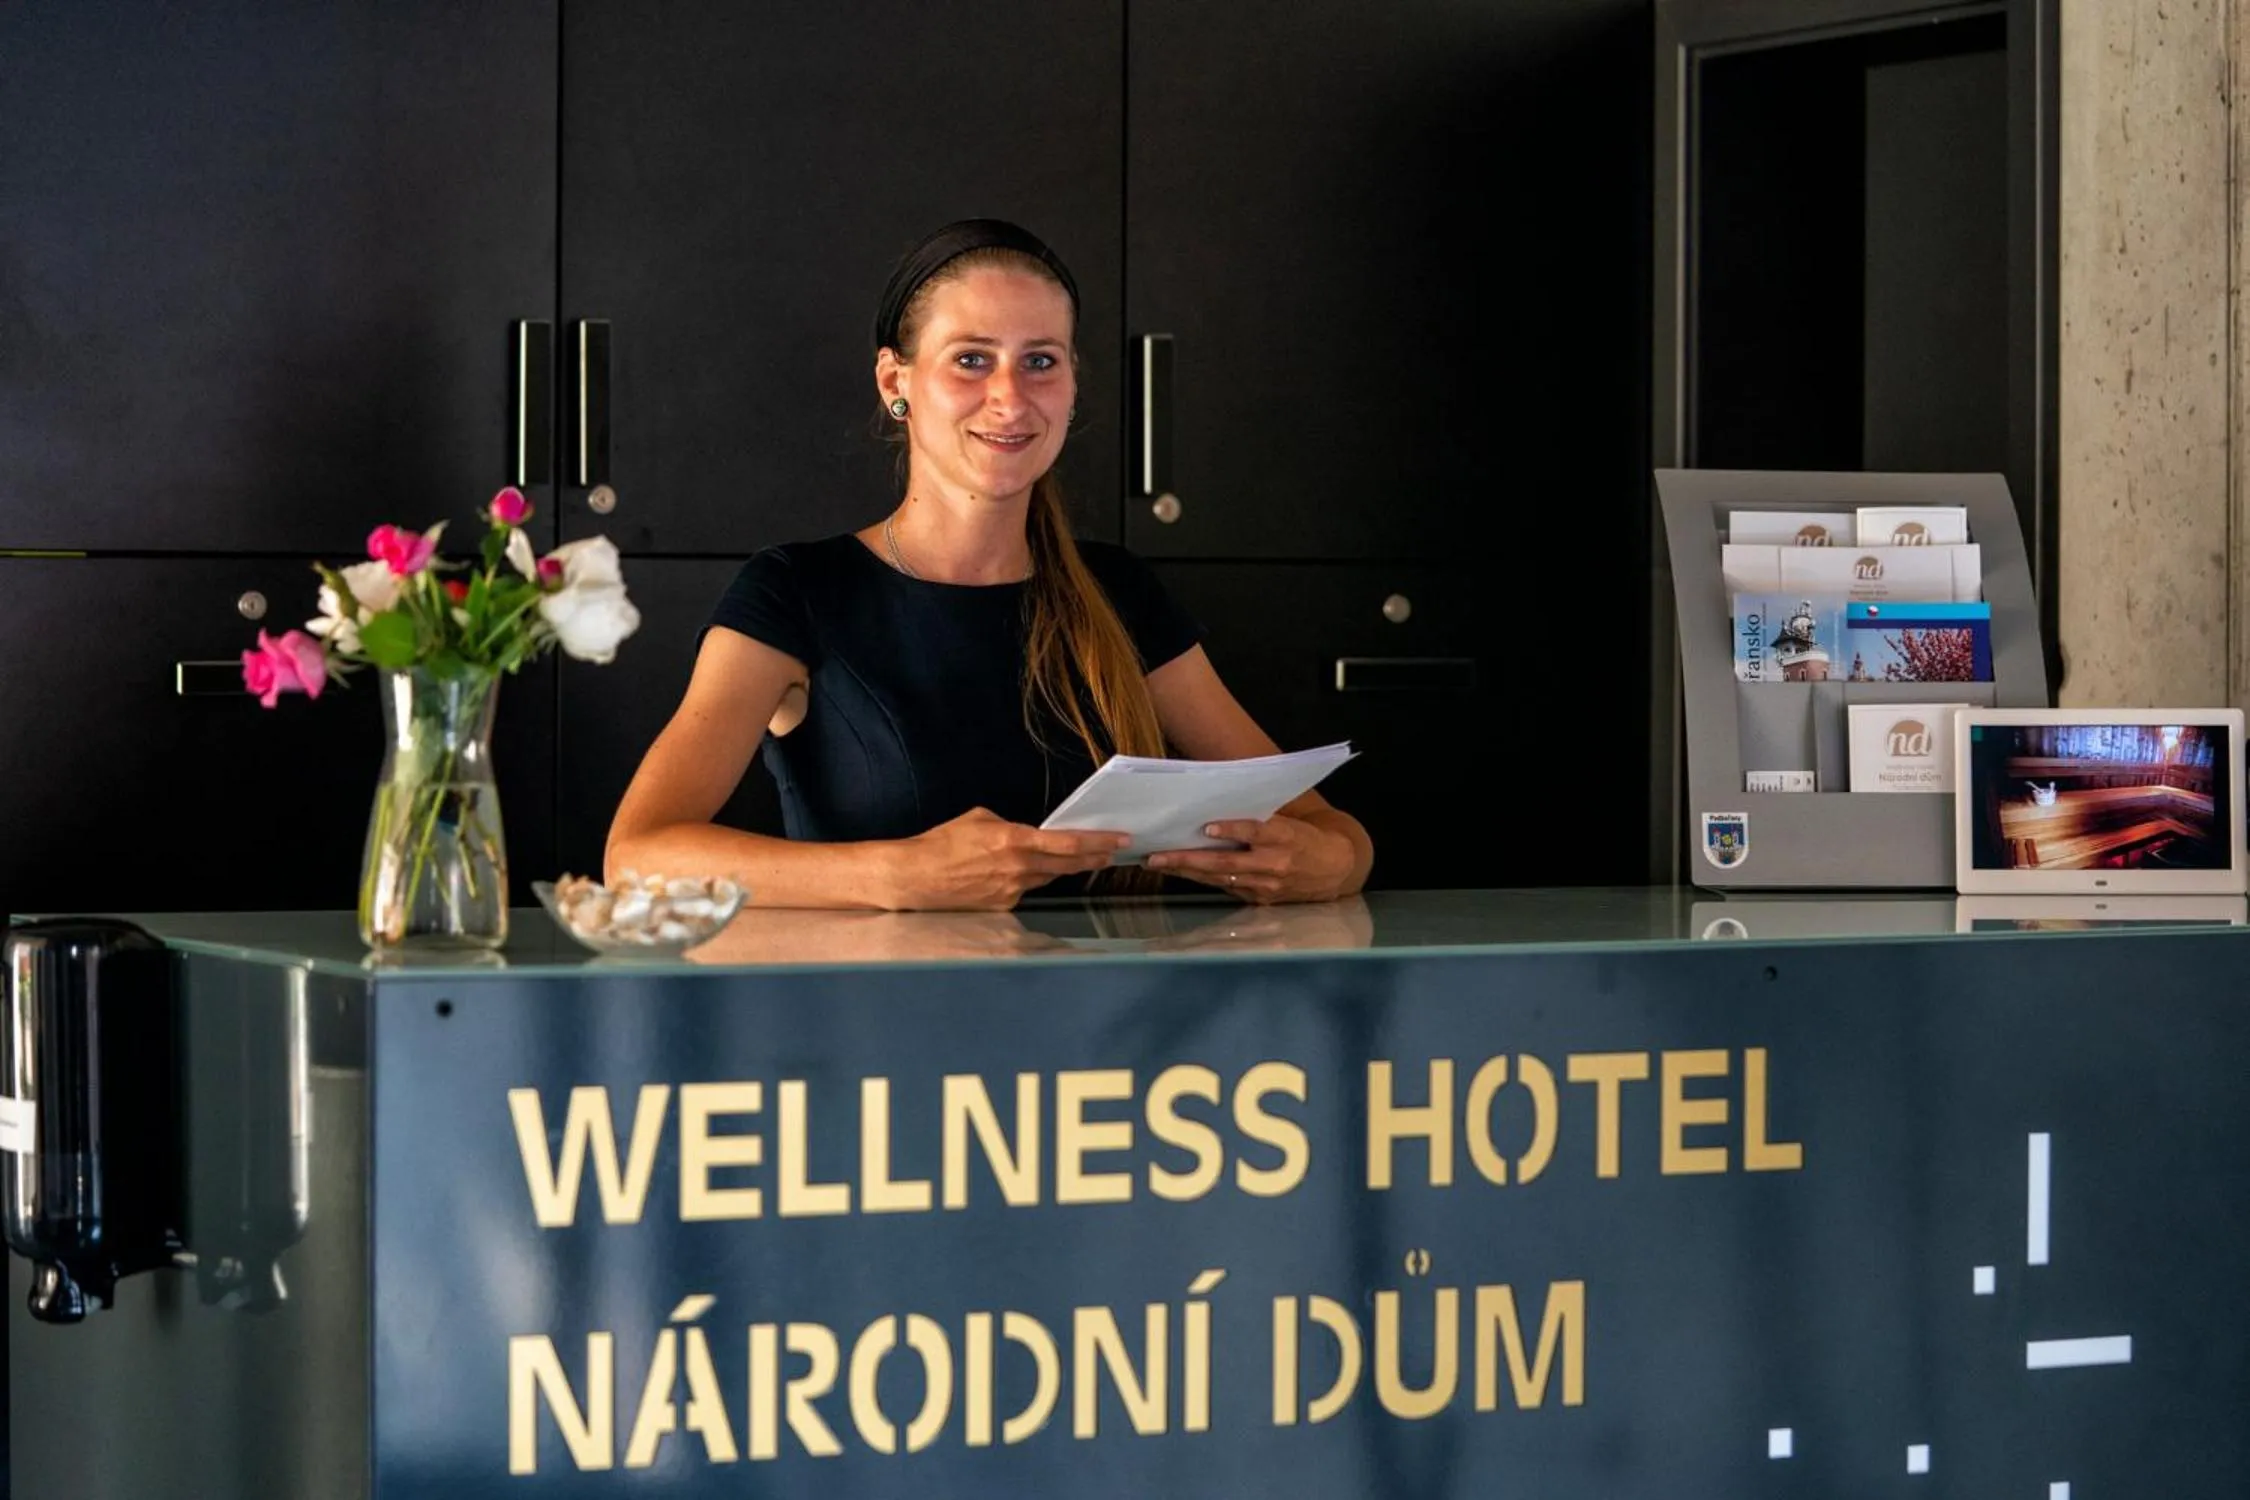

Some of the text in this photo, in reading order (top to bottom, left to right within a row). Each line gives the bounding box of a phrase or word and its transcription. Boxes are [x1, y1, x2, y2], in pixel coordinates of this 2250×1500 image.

[1855, 559, 1882, 579] nd
[1886, 724, 1931, 756] nd
[509, 1049, 1802, 1227] WELLNESS HOTEL
[509, 1249, 1584, 1474] NÁRODNÍ DŮM
